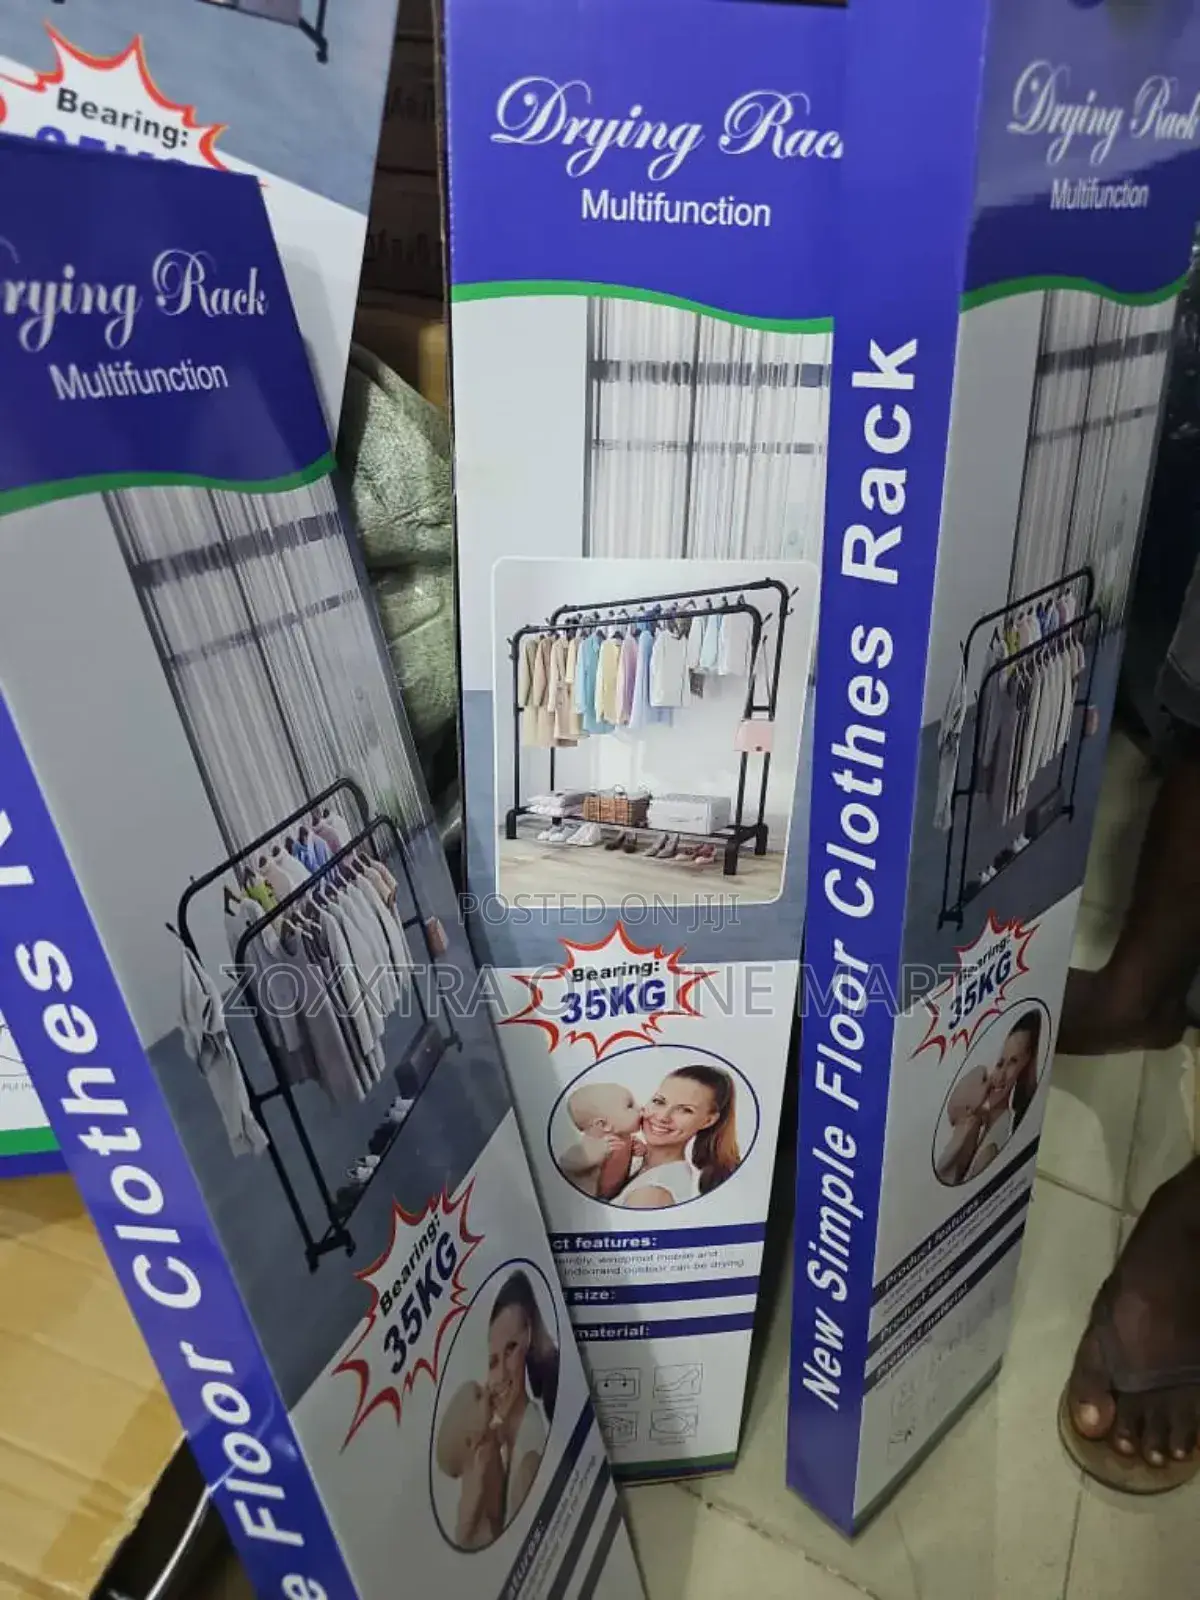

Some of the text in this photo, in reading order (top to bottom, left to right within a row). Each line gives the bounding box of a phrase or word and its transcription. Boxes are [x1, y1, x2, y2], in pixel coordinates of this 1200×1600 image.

[56, 87, 190, 149] Bearing:
[490, 75, 704, 181] Drying
[1006, 59, 1123, 166] Drying
[581, 188, 772, 227] Multifunction
[1050, 176, 1150, 210] Multifunction
[0, 240, 268, 352] rying Rack
[49, 358, 229, 400] Multifunction
[802, 337, 918, 1411] New Simple Floor Clothes Rack
[560, 979, 666, 1025] 35KG
[571, 960, 660, 983] Bearing:
[948, 950, 1012, 1030] 35KG
[15, 938, 305, 1547] Floor Clothes
[379, 1213, 441, 1317] Bearing:
[575, 1235, 658, 1249] features:
[383, 1231, 458, 1375] 35KG
